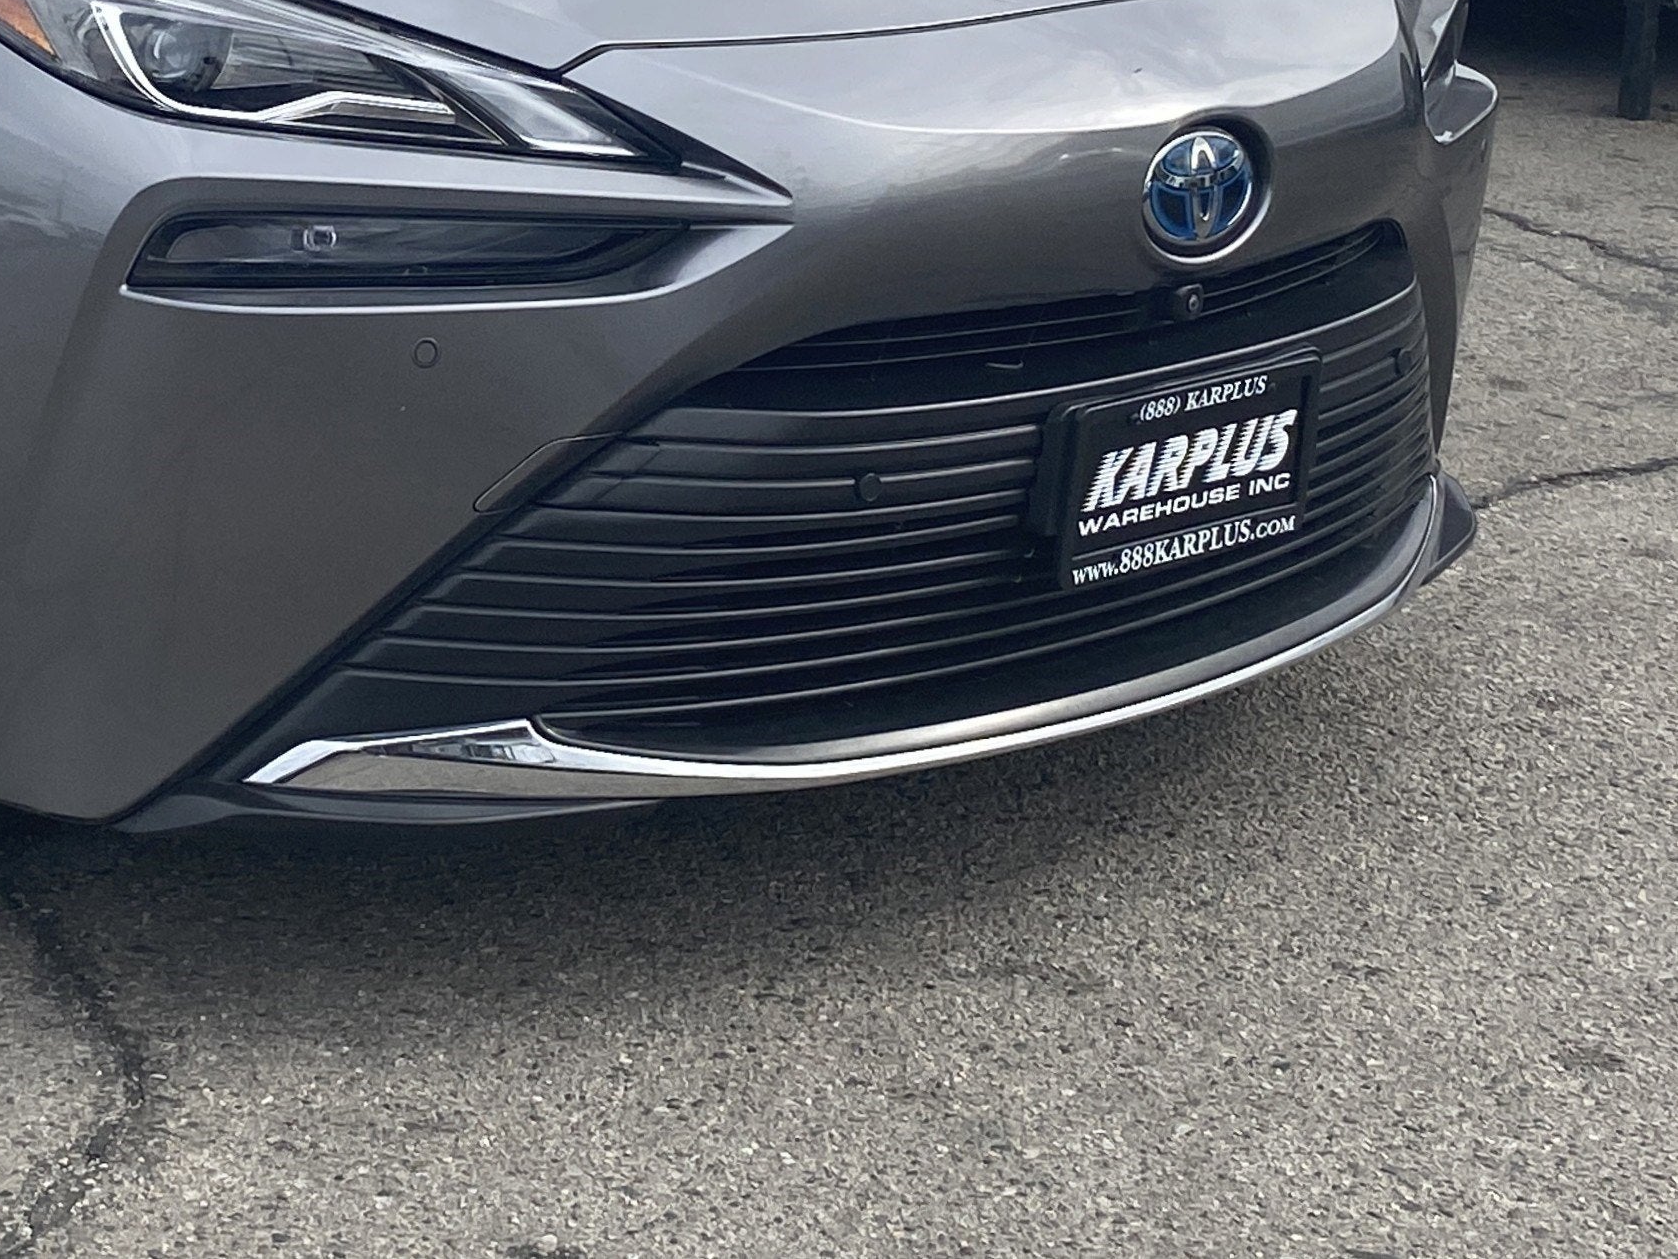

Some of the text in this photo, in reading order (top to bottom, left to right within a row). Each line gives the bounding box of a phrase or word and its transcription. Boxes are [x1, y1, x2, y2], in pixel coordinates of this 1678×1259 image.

[1138, 374, 1269, 422] (888) KARPLUS
[1079, 408, 1299, 514] KARPLUS
[1077, 472, 1292, 538] WAREHOUSE INC
